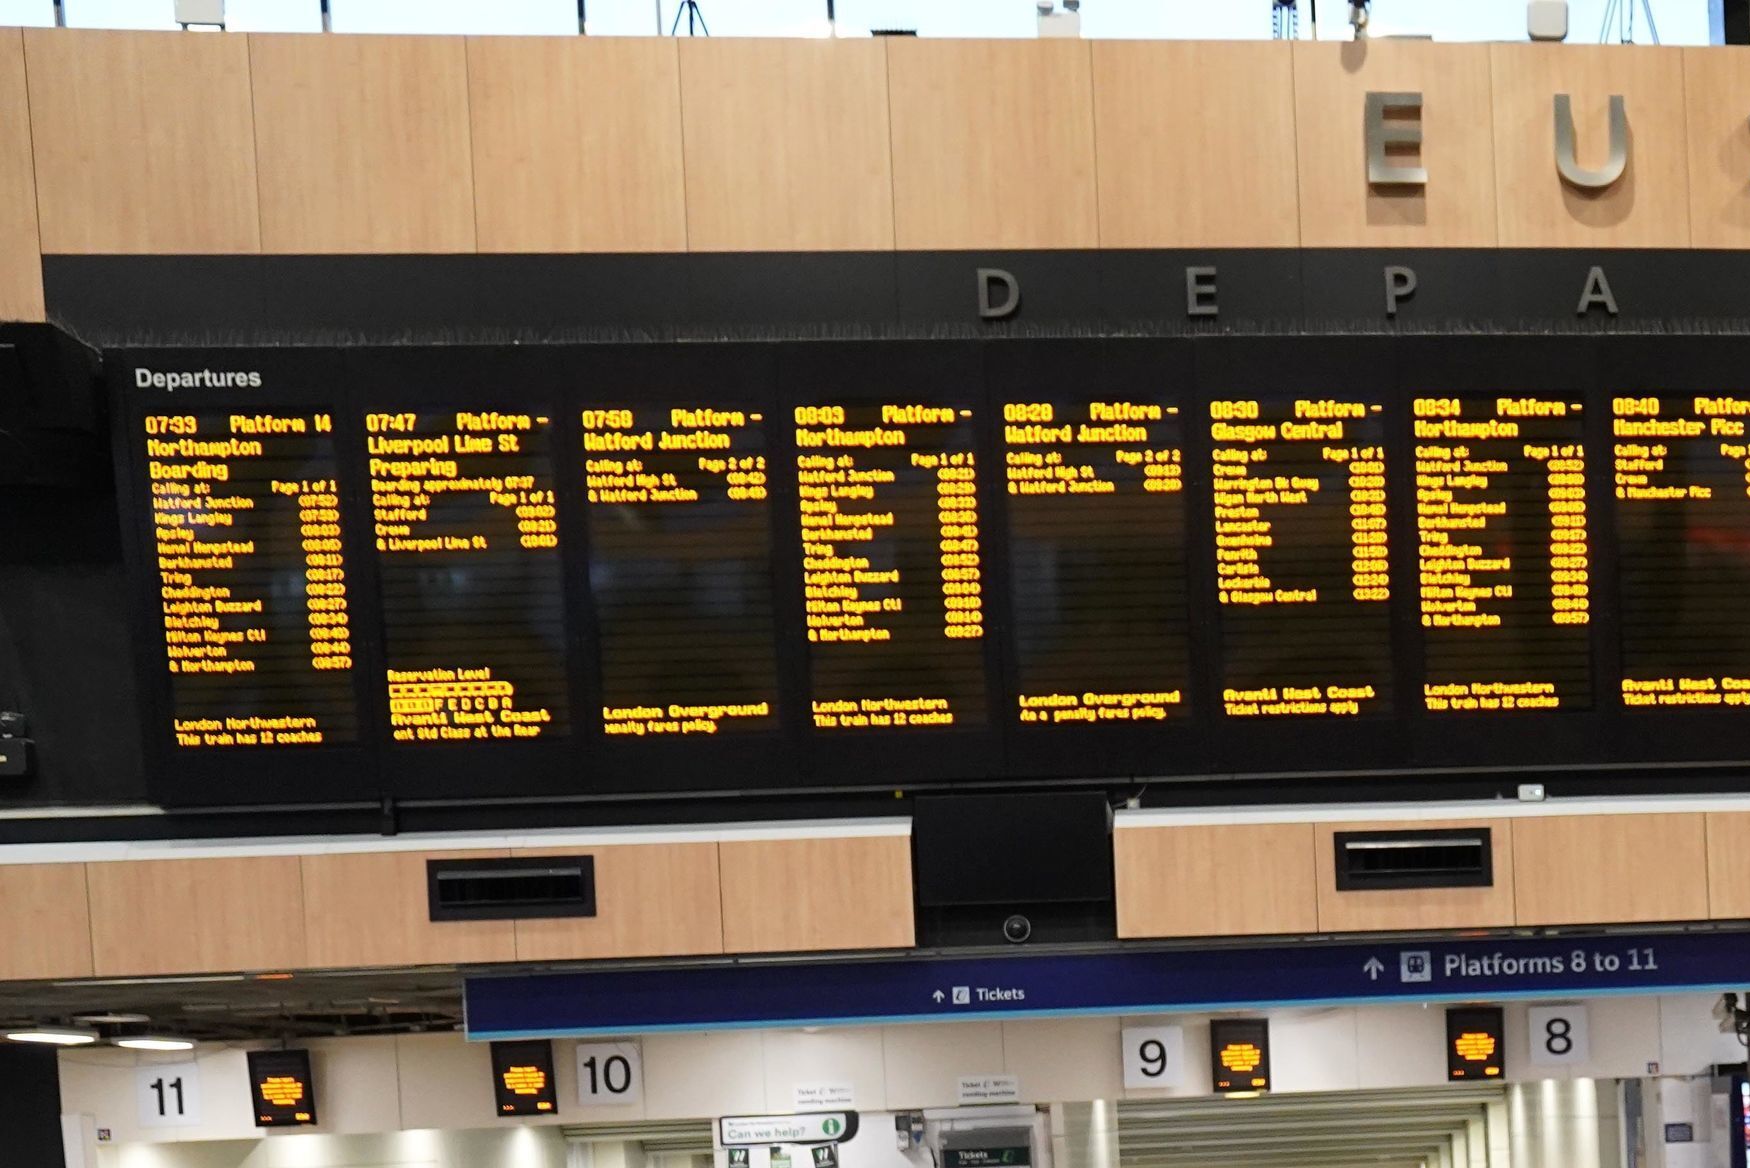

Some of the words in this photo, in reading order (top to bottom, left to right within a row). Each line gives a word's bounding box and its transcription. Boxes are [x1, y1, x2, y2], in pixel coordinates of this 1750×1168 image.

[135, 368, 262, 391] Departures
[882, 405, 955, 424] Platform
[1090, 402, 1162, 421] Platform
[1295, 400, 1365, 418] Platform
[1497, 398, 1566, 416] Platform
[145, 416, 197, 434] 07:33
[229, 415, 306, 433] Platform
[314, 414, 332, 432] 14
[366, 413, 416, 432] 07:47
[456, 412, 531, 430] Platform
[671, 408, 745, 427] Platform
[1613, 418, 1706, 436] Manchester
[1711, 418, 1744, 436] Picc
[796, 427, 905, 447] Northampton
[1005, 424, 1072, 443] Watford
[1077, 424, 1147, 442] Junction
[1211, 422, 1276, 442] Glasgow
[1281, 421, 1343, 440] Central
[1414, 419, 1519, 439] Northampton
[147, 438, 262, 458] Northampton
[368, 435, 449, 456] Liverpool
[454, 434, 492, 453] Lime
[498, 434, 520, 452] St
[584, 431, 654, 451] Watford
[658, 430, 731, 449] Junction
[150, 461, 229, 480] Boarding
[370, 458, 457, 478] Preparing
[812, 700, 858, 713] London
[1019, 693, 1078, 707] London
[603, 706, 663, 720] London
[174, 718, 222, 732] London
[1444, 949, 1564, 978] Platforms
[1570, 951, 1587, 973] 8
[1592, 950, 1620, 973] to
[1626, 948, 1658, 971] 11
[976, 986, 1025, 1002] Tickets
[1545, 1018, 1574, 1056] 8
[1138, 1039, 1167, 1077] 9
[582, 1056, 632, 1095] 10
[150, 1077, 184, 1116] 11
[728, 1128, 751, 1140] Can
[755, 1129, 771, 1138] we
[775, 1126, 806, 1138] help?
[958, 1150, 988, 1160] Tickets
